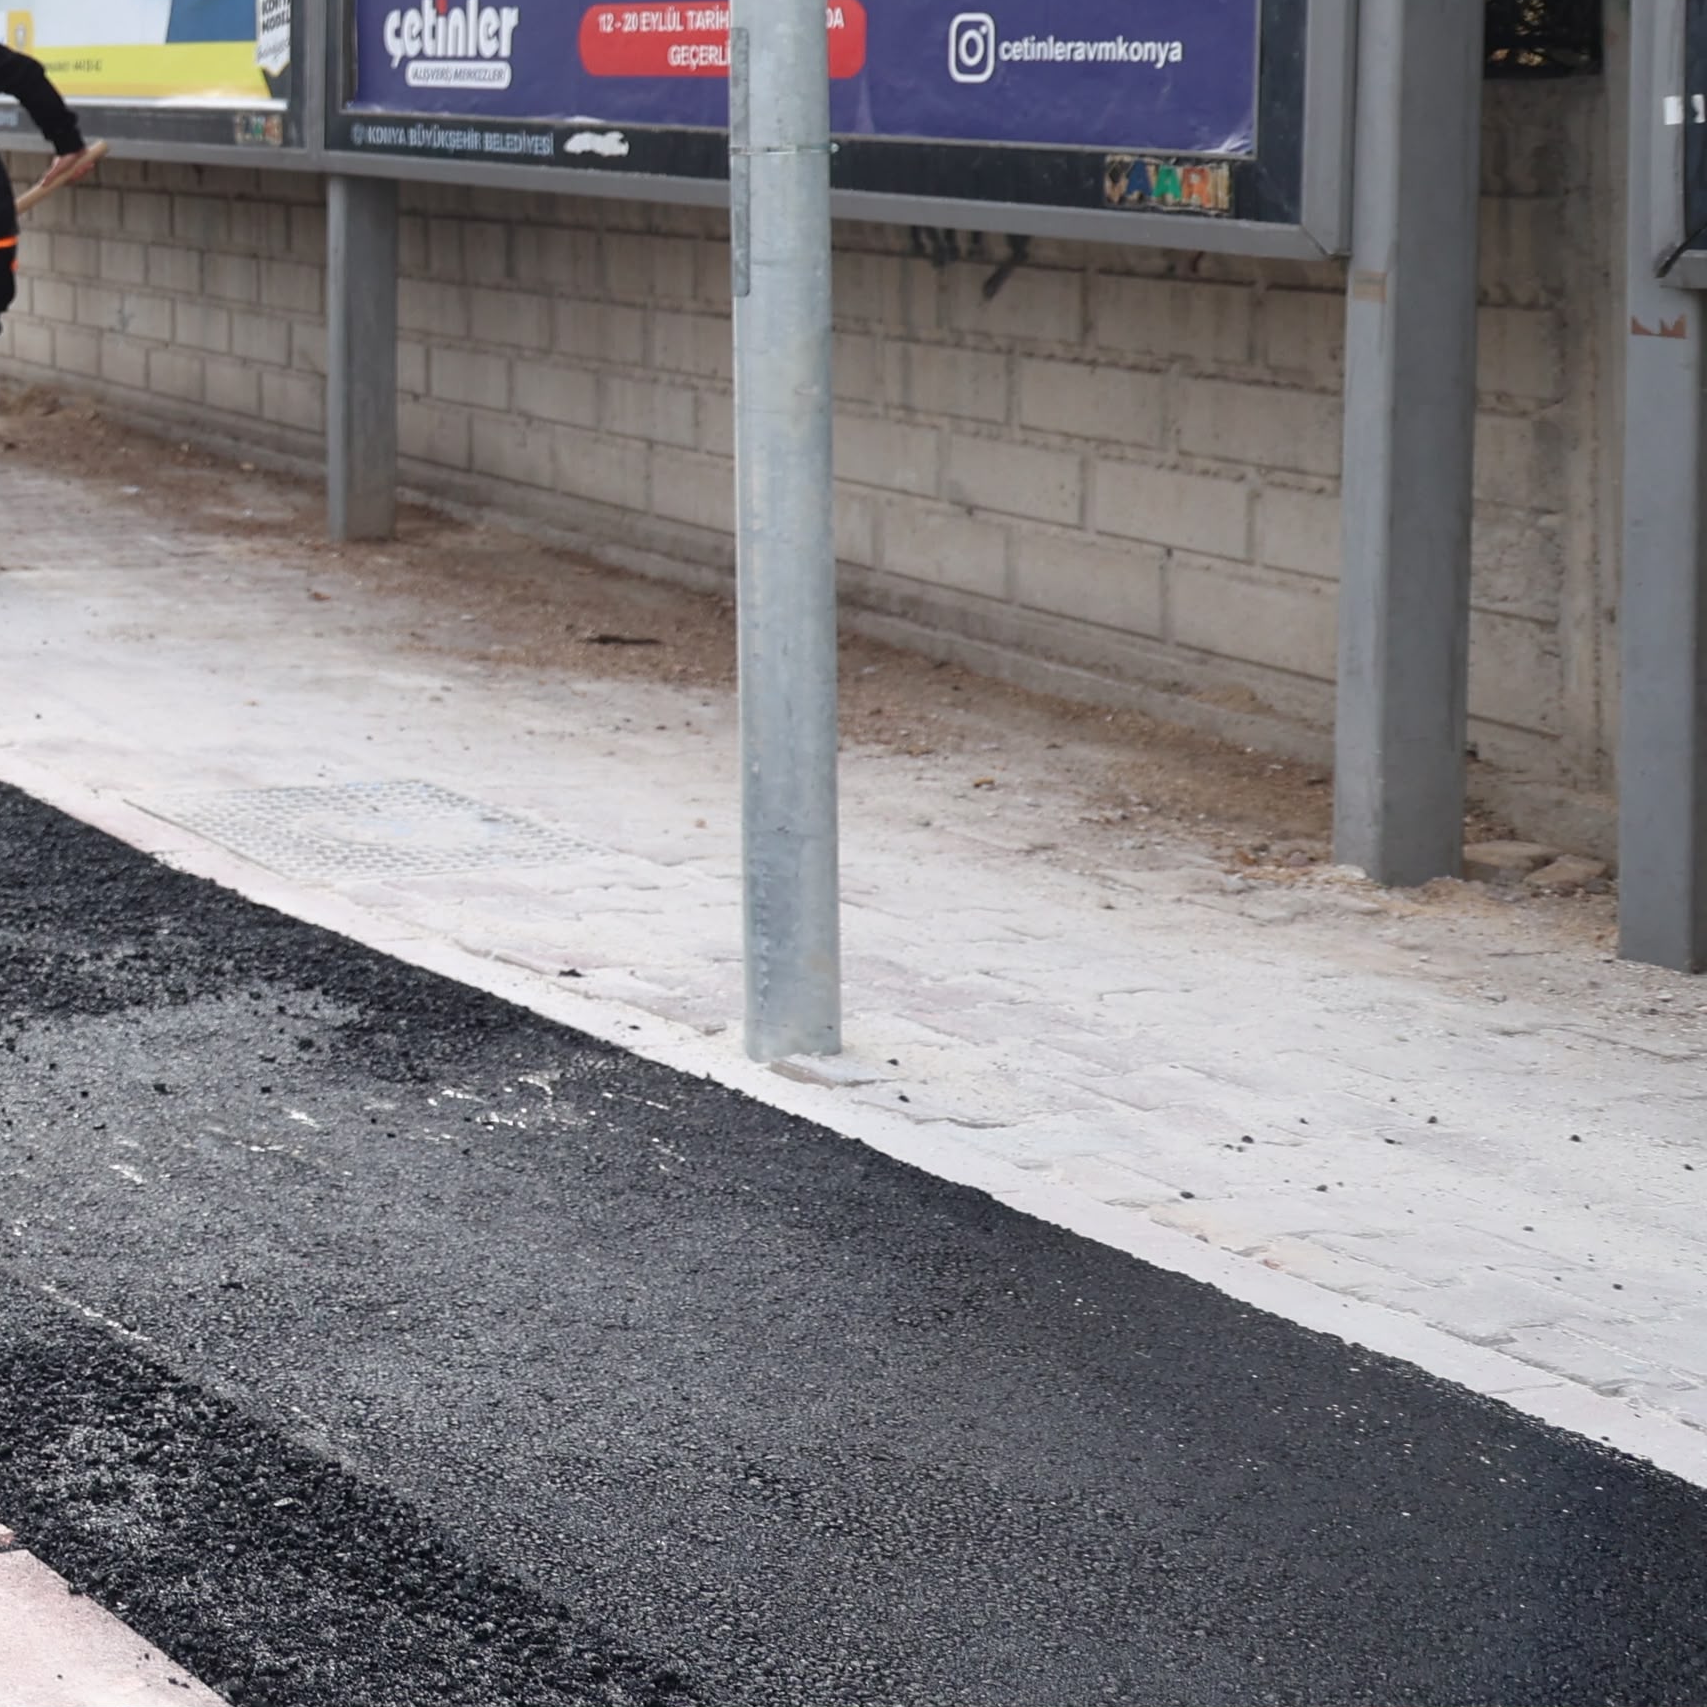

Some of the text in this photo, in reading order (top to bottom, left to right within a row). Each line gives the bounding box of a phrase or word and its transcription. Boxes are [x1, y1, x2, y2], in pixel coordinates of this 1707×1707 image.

[598, 13, 614, 33] 12
[622, 12, 639, 32] 20
[640, 5, 685, 32] EYLÜL
[686, 4, 730, 30] TARİH
[667, 40, 731, 71] GEÇERLİ
[999, 36, 1183, 69] cetinleravmkonya
[368, 124, 555, 157] KONYA BÜYÜKŞEHİR BELEDİYESİ
